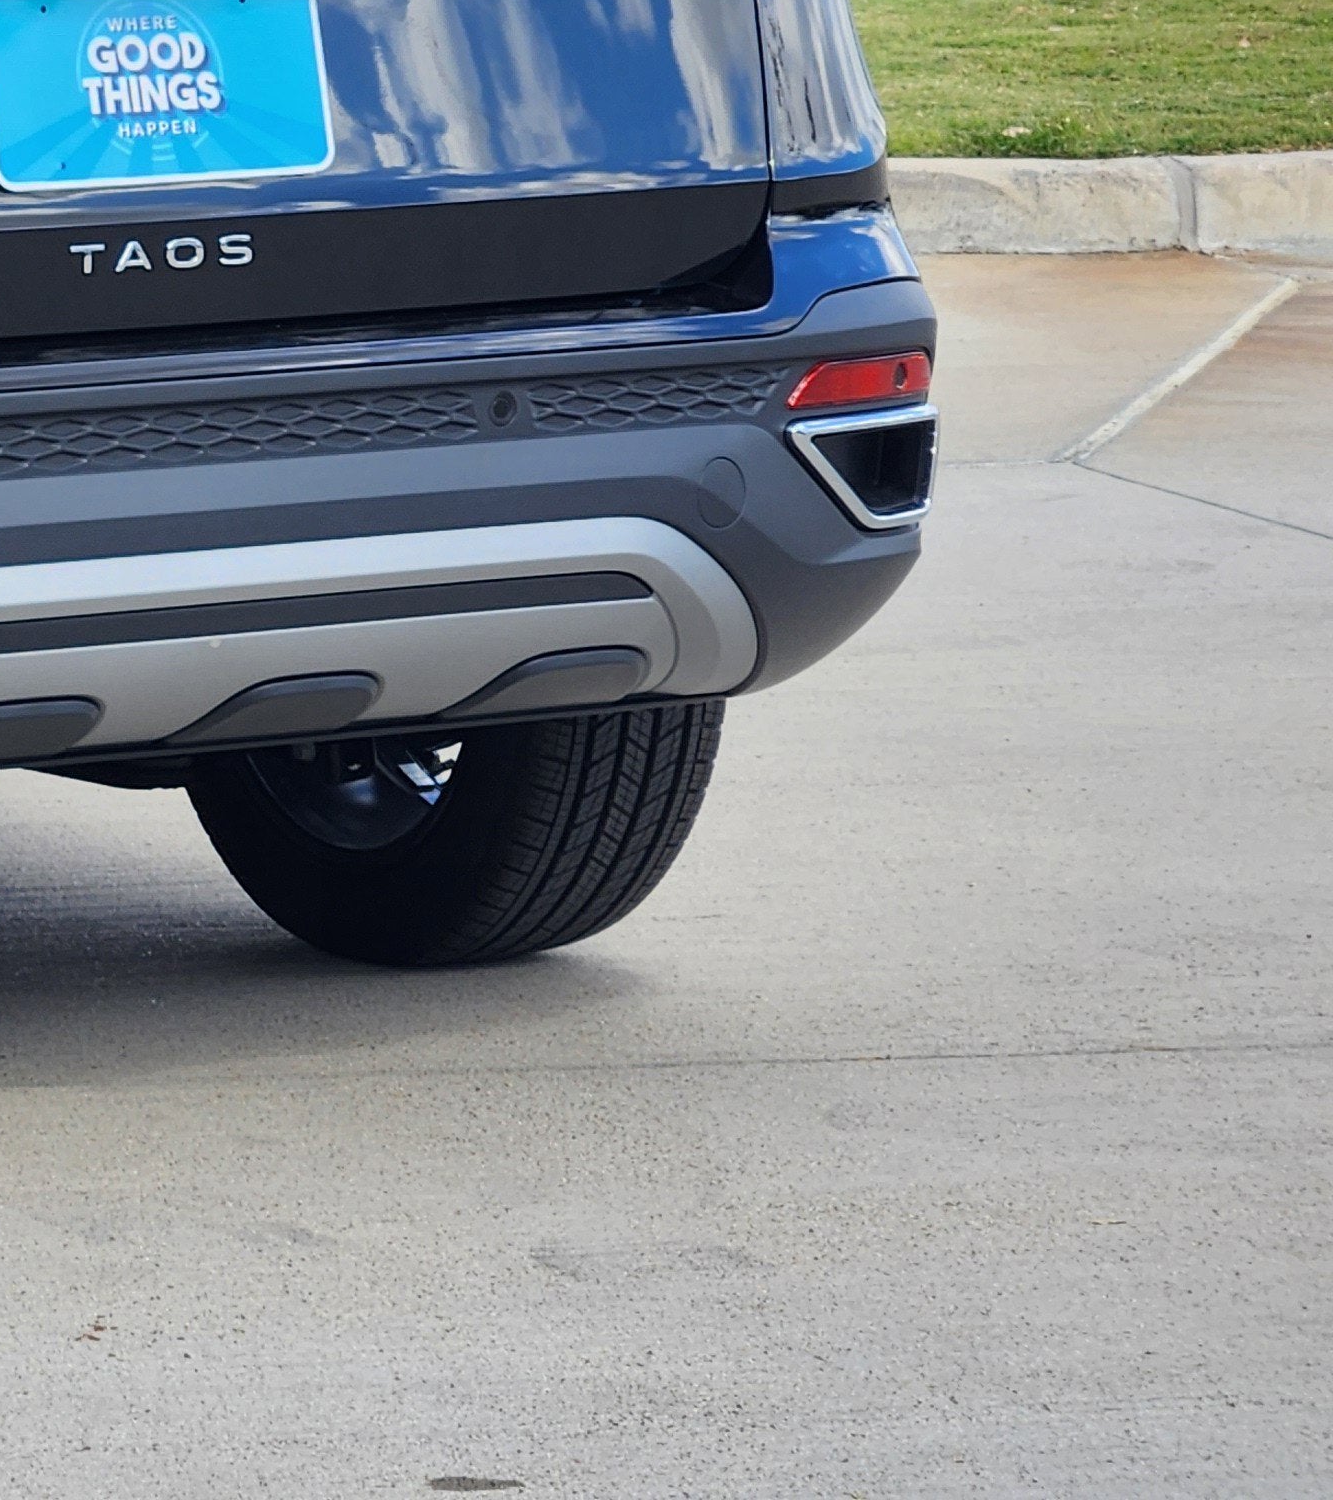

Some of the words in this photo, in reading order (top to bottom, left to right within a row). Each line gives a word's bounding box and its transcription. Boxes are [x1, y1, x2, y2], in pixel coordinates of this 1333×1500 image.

[107, 15, 177, 31] WHERE
[87, 32, 206, 73] GOOD
[82, 71, 222, 116] THINGS
[118, 120, 197, 138] HAPPEN
[69, 233, 253, 274] TAOS
